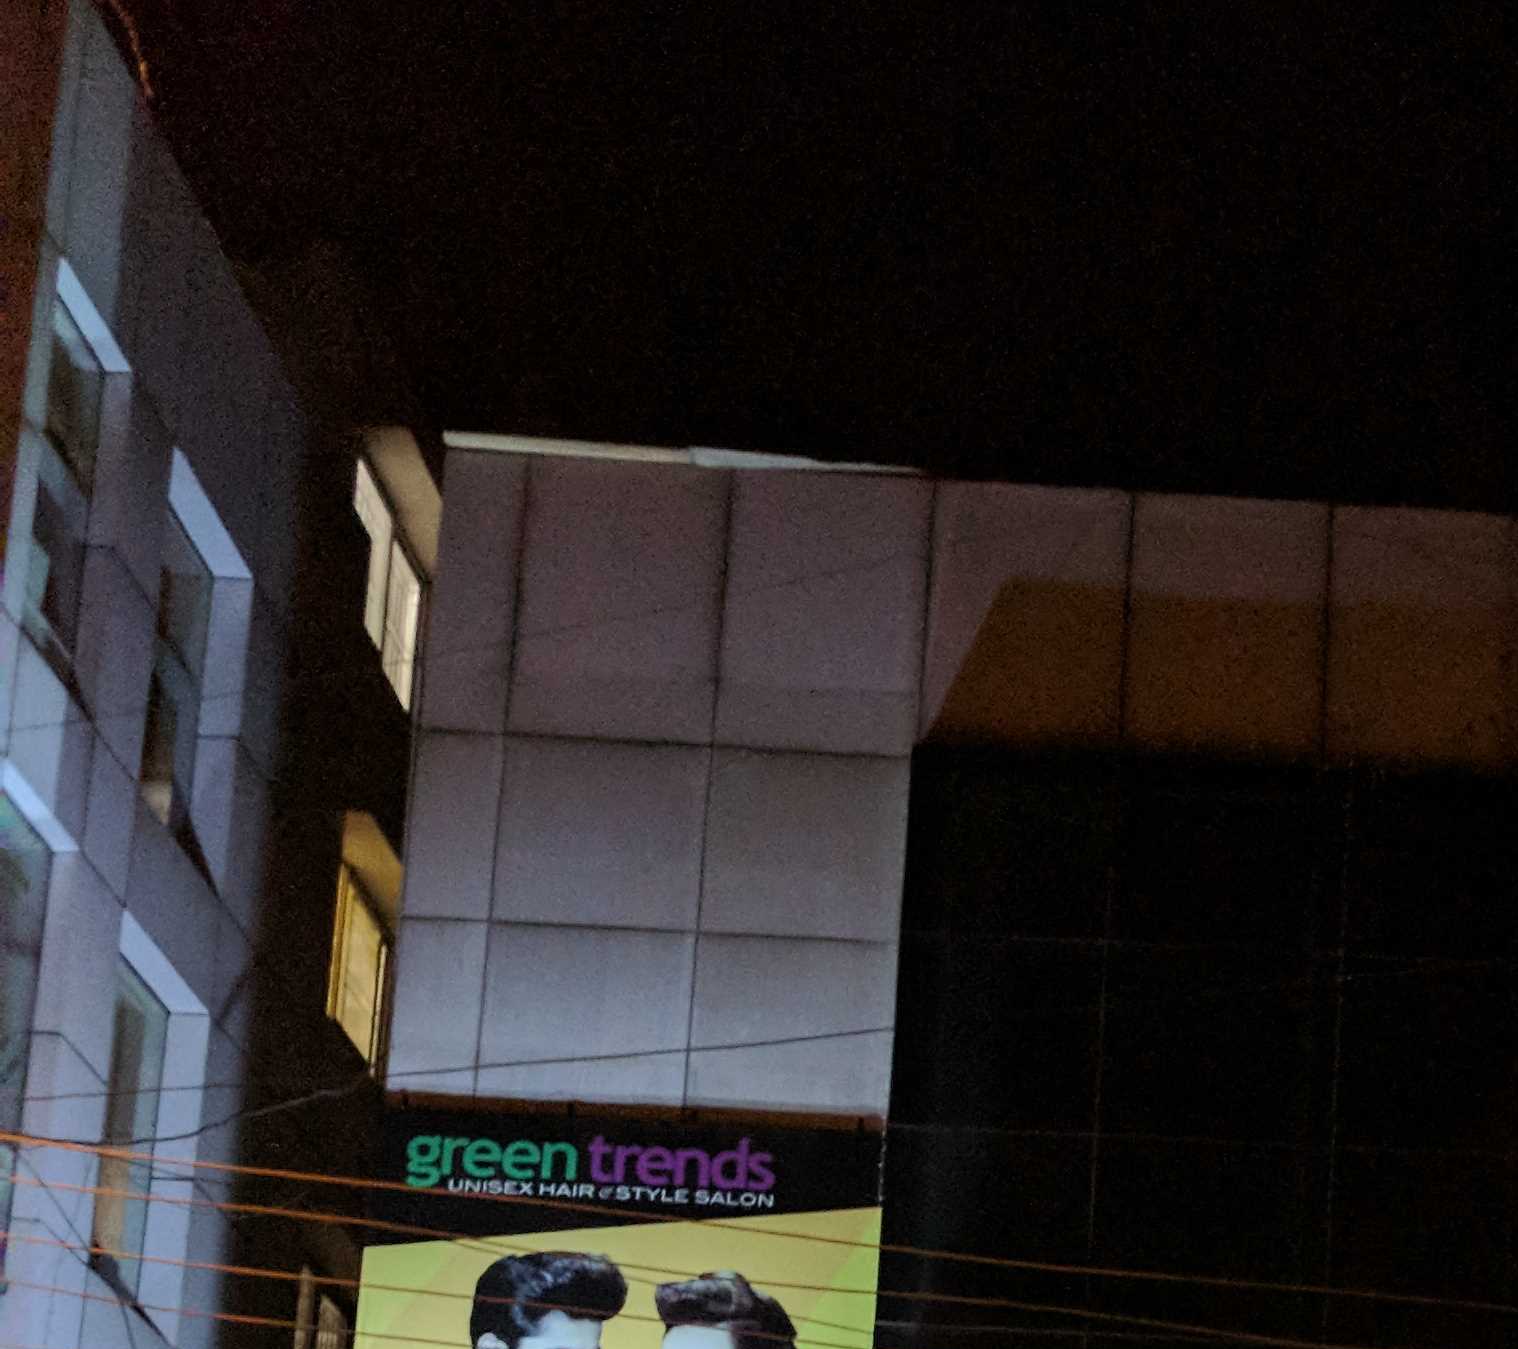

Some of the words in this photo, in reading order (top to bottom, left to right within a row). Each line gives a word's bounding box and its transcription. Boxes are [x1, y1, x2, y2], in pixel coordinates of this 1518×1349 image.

[406, 1135, 578, 1187] green
[588, 1136, 775, 1190] trends
[448, 1178, 532, 1197] UNISEX
[538, 1182, 594, 1199] HAIR
[615, 1185, 688, 1204] STYLE
[694, 1188, 774, 1208] SALON
